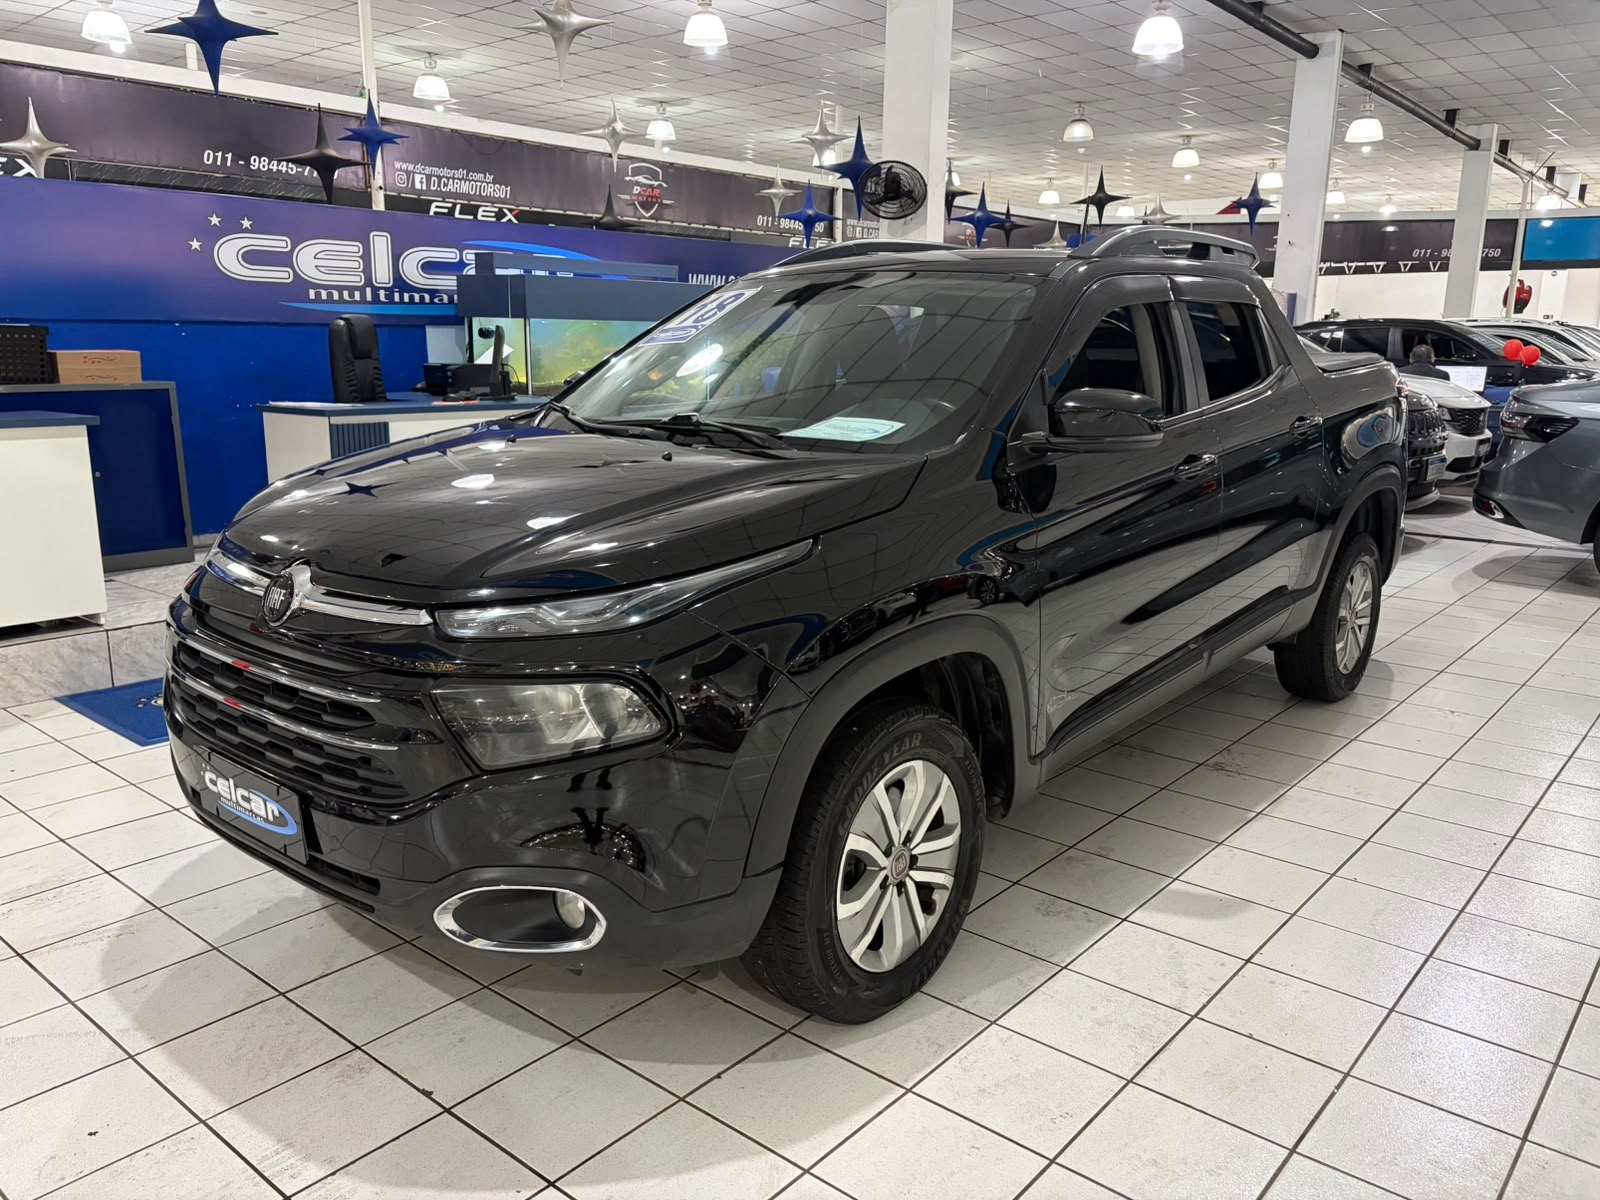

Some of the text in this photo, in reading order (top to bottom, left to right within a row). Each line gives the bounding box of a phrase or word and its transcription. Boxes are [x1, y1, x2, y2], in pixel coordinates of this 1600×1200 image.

[203, 150, 232, 167] 011
[394, 160, 494, 182] www.dcarmotors01.com.br
[430, 177, 511, 199] D.CARMOTORS01
[632, 186, 660, 197] DCAR
[429, 201, 519, 223] FLEX
[757, 215, 772, 227] 011
[788, 237, 836, 249] FLE
[1412, 248, 1431, 257] 011
[204, 769, 280, 822] celcar
